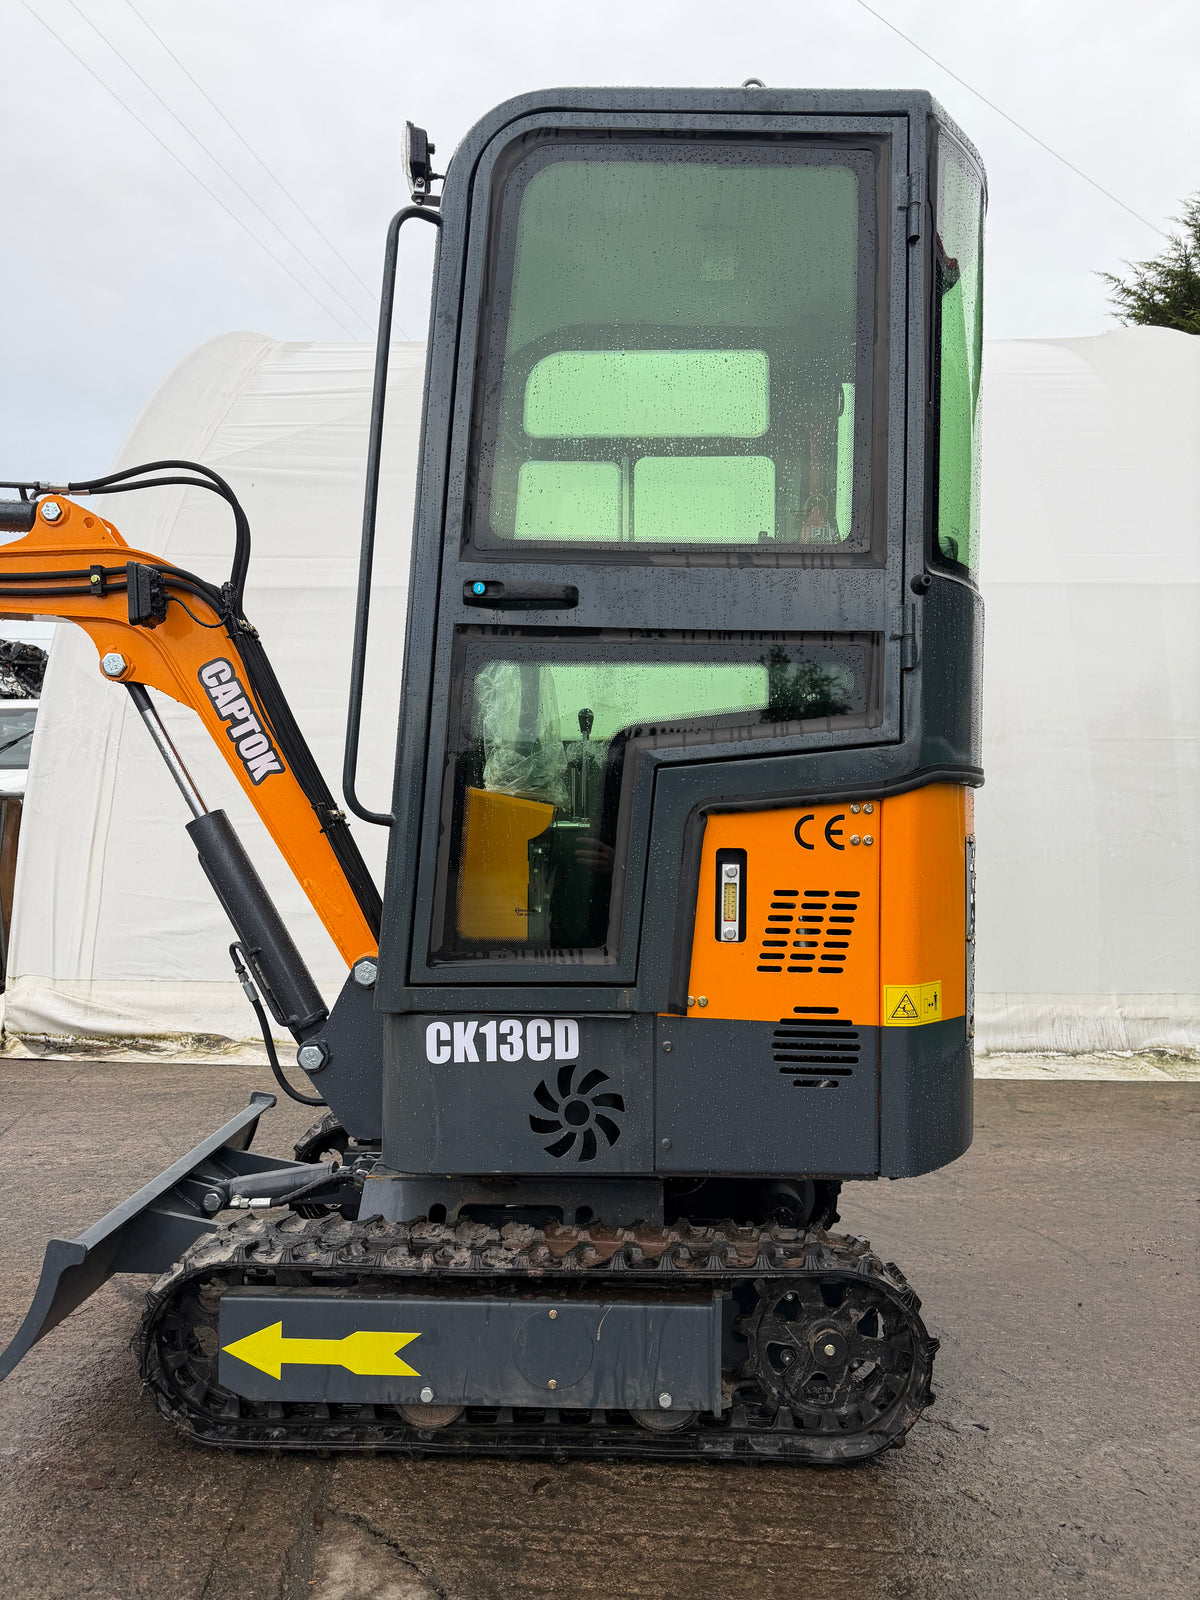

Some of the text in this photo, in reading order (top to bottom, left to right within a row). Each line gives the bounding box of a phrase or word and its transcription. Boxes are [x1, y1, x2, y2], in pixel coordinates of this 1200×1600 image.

[200, 659, 283, 783] CAPTOK
[794, 814, 845, 851] CE
[425, 1018, 580, 1065] CK13CD
